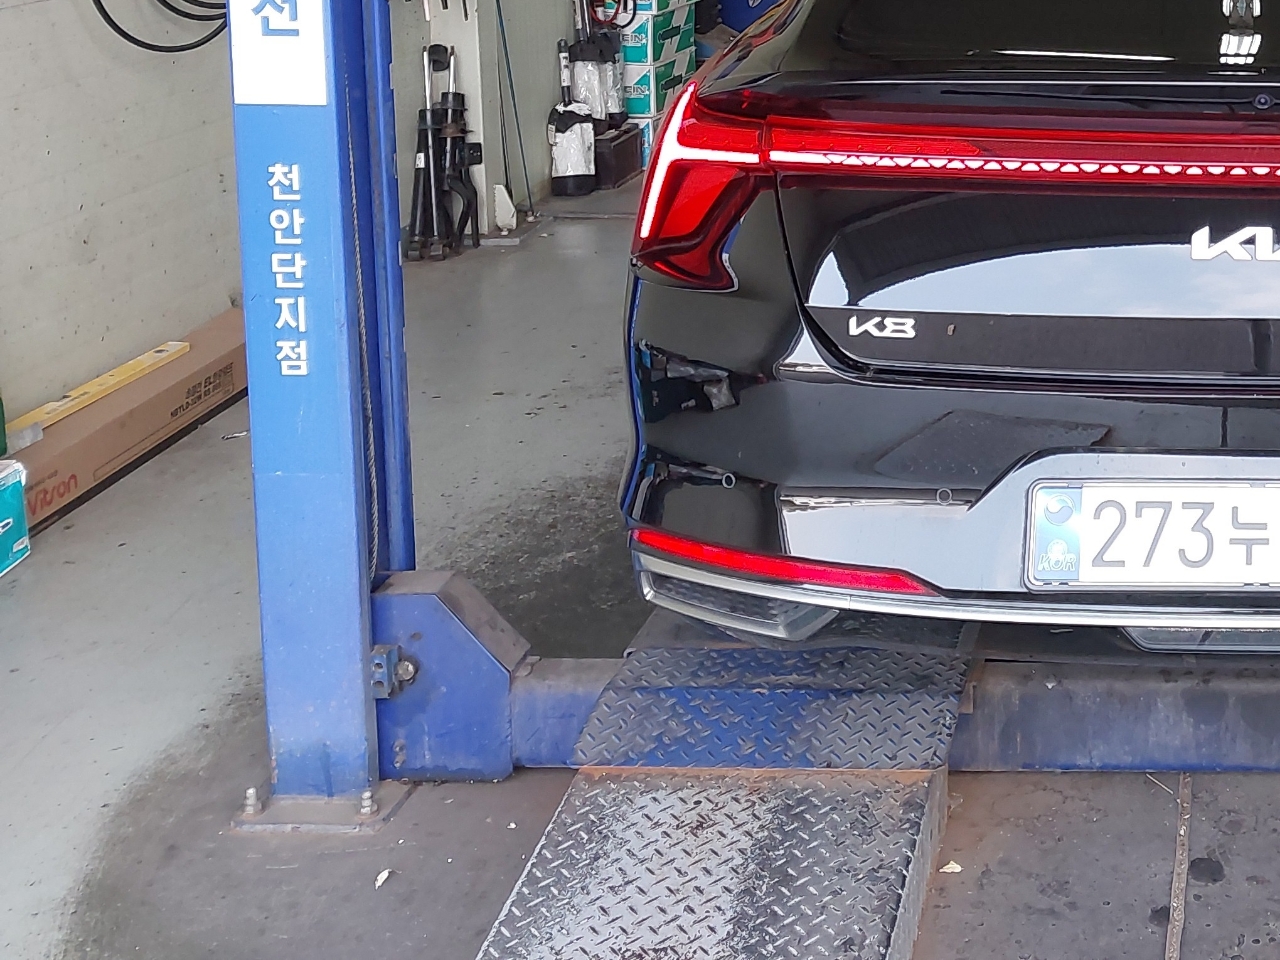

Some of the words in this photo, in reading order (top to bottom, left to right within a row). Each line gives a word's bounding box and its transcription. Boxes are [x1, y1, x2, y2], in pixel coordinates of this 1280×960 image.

[267, 162, 310, 376] 천안단지점
[849, 316, 916, 339] K8
[1091, 499, 1270, 569] 273누
[1038, 553, 1076, 571] KOR
